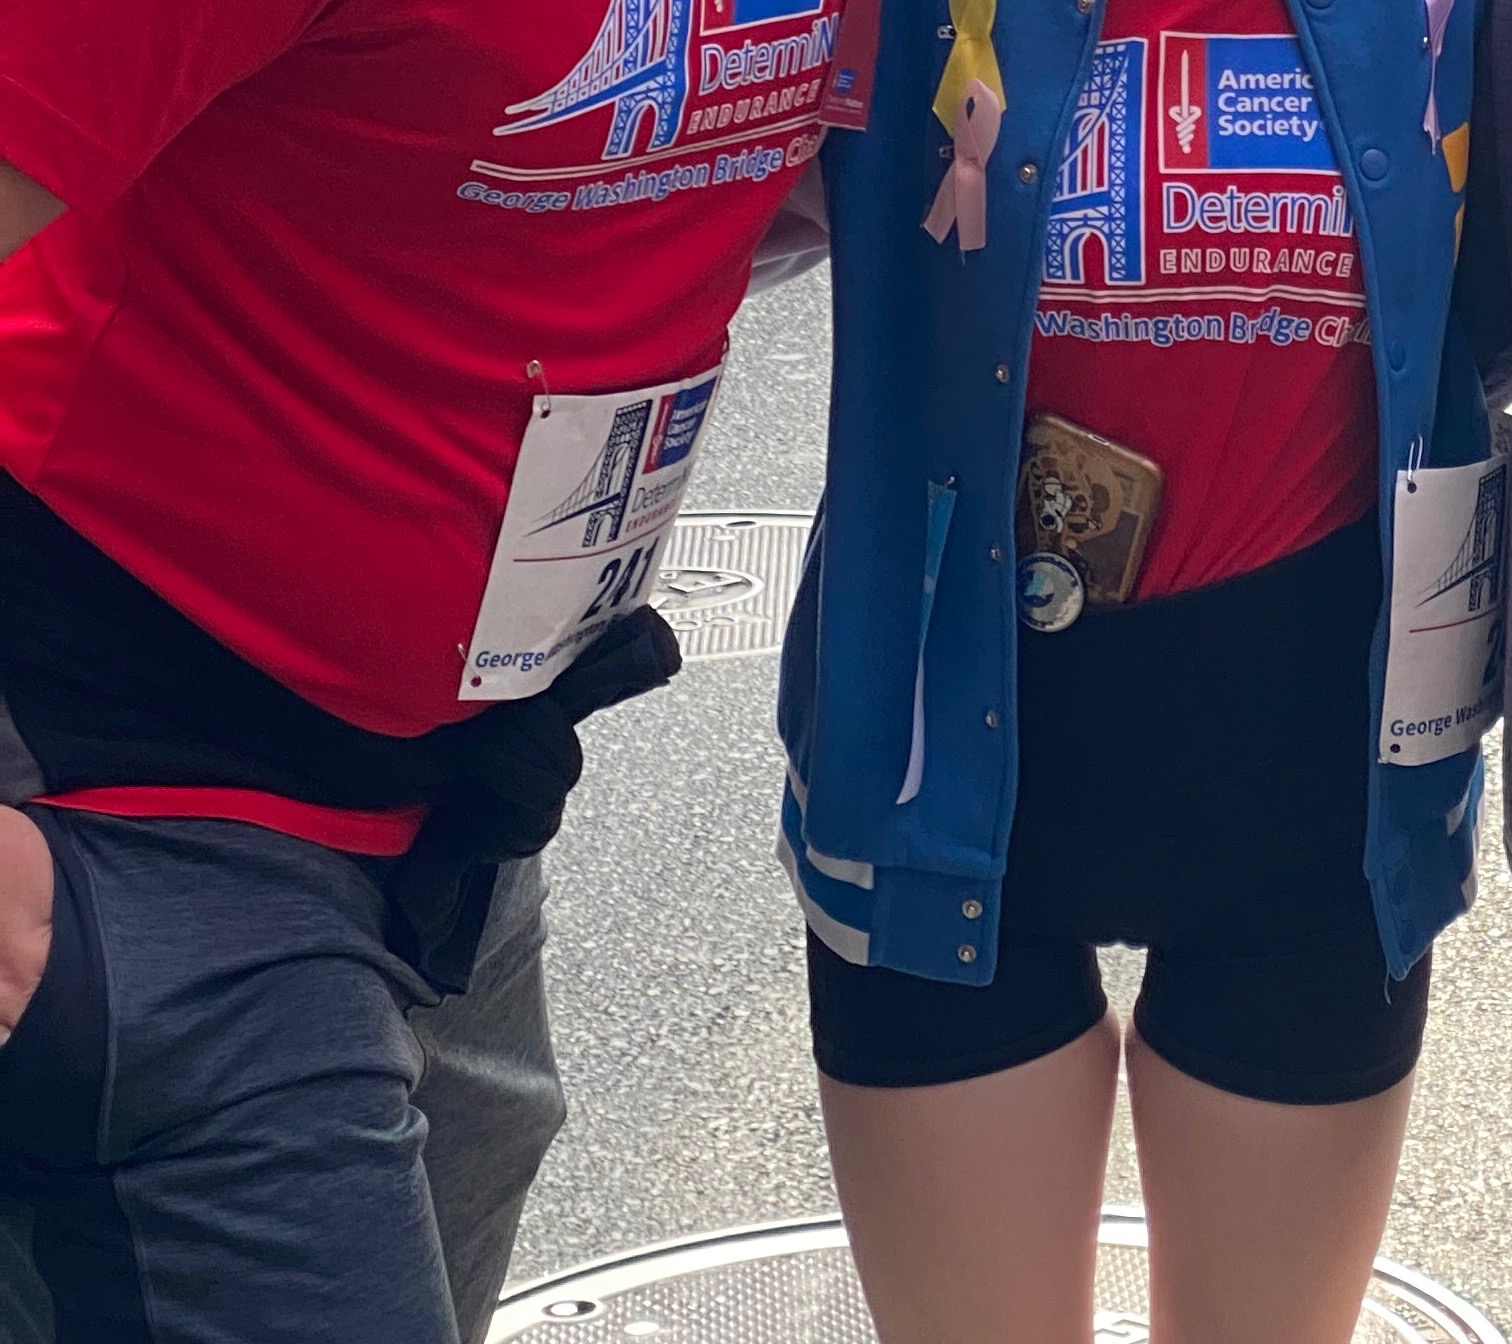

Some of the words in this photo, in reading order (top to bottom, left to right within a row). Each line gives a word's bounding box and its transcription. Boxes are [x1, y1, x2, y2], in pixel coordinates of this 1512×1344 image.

[686, 79, 822, 126] ENDURANCE
[1217, 92, 1313, 114] Cancer
[1217, 114, 1319, 143] Society
[456, 181, 571, 214] George
[572, 162, 709, 212] Washington
[711, 145, 784, 185] Bridge
[1160, 248, 1354, 278] ENDURANCE
[1034, 310, 1224, 348] Washington
[475, 650, 546, 672] George
[1390, 714, 1452, 737] George
